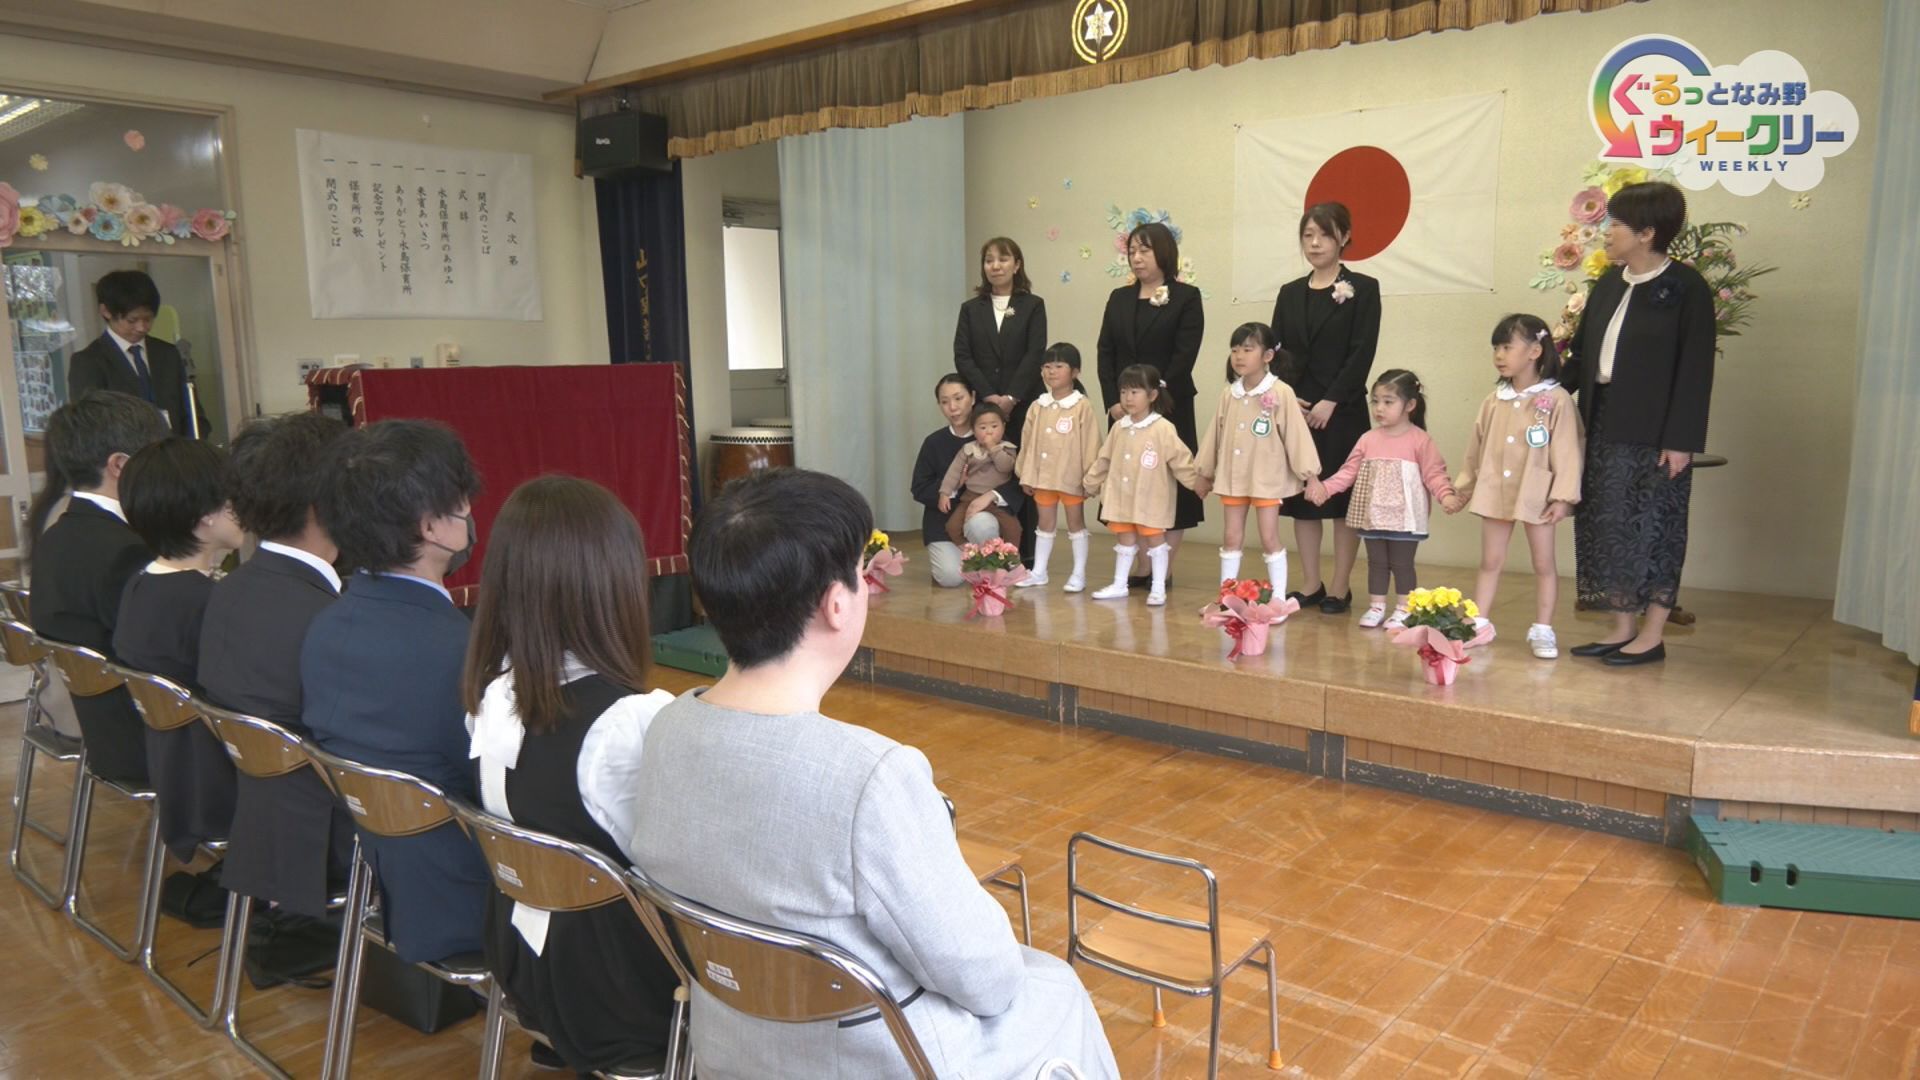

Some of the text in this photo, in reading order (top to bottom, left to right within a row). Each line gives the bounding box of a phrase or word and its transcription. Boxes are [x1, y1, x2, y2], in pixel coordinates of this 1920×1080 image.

[372, 182, 388, 273] 記念品プレゼント
